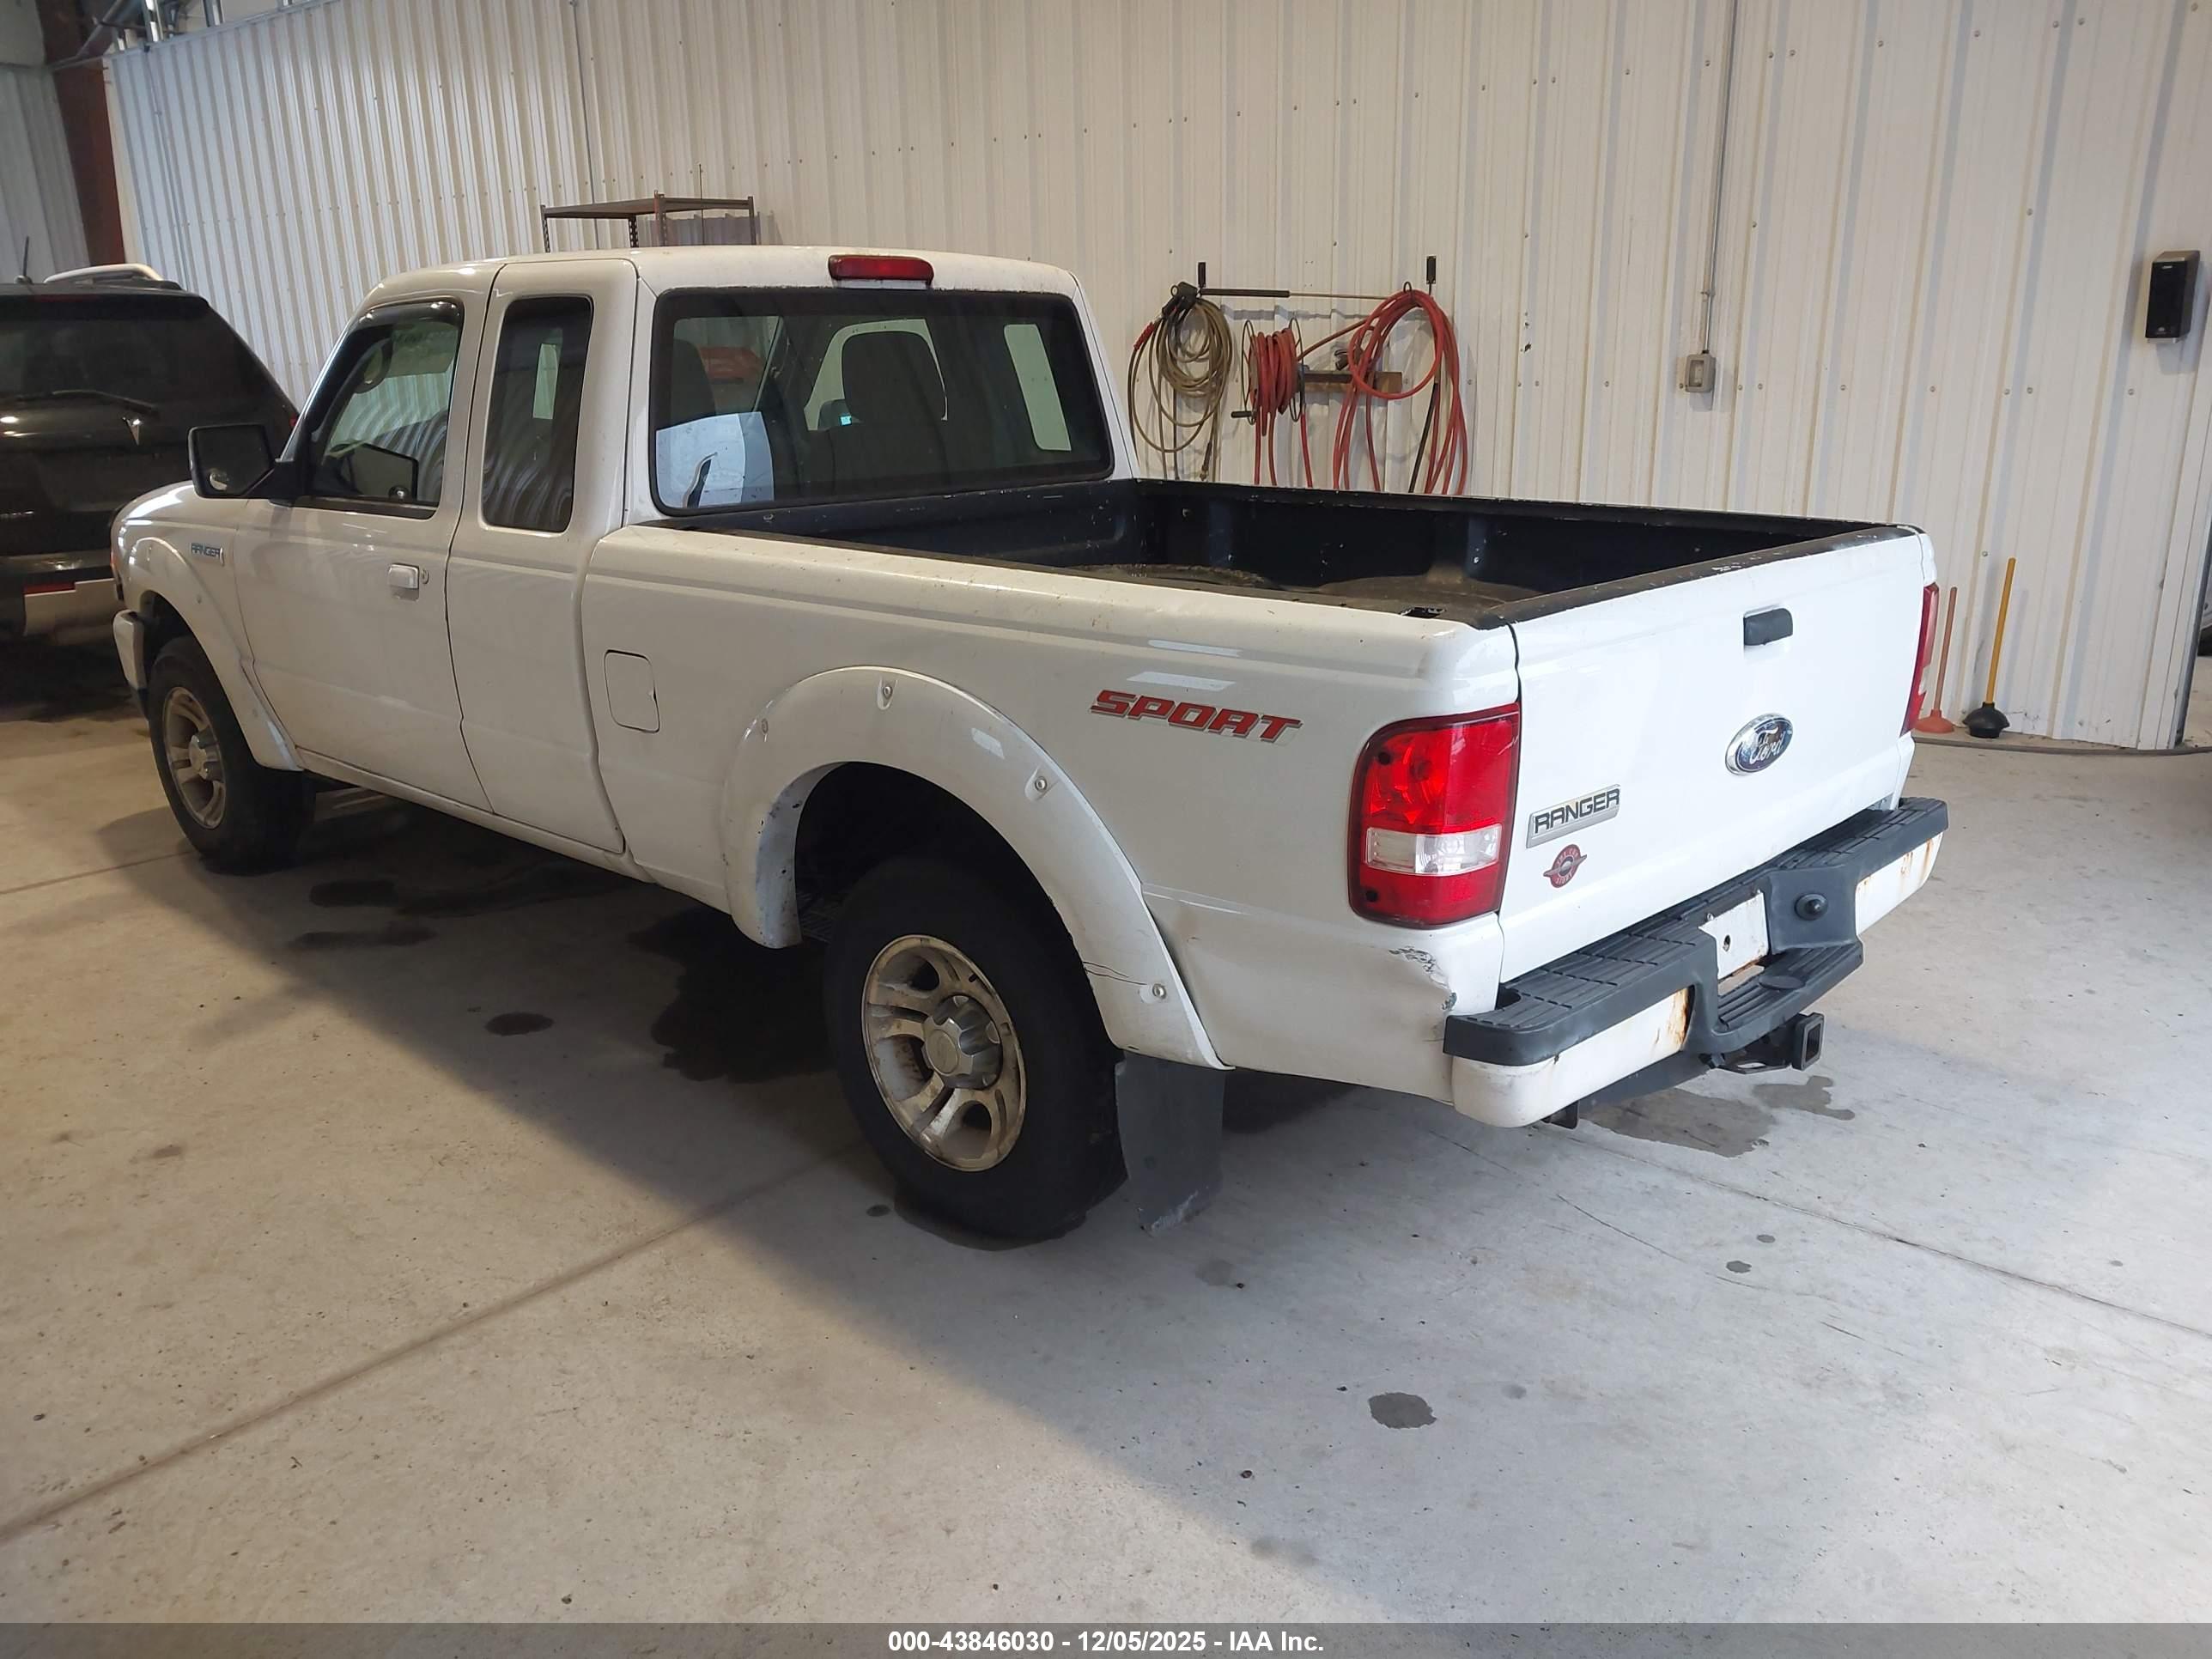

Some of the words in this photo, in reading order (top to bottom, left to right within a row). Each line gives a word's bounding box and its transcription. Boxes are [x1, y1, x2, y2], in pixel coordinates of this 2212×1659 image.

[191, 543, 222, 559] RANGER
[1090, 689, 1304, 743] SPORT
[1749, 726, 1787, 764] Ford
[1534, 788, 1620, 834] RANGER
